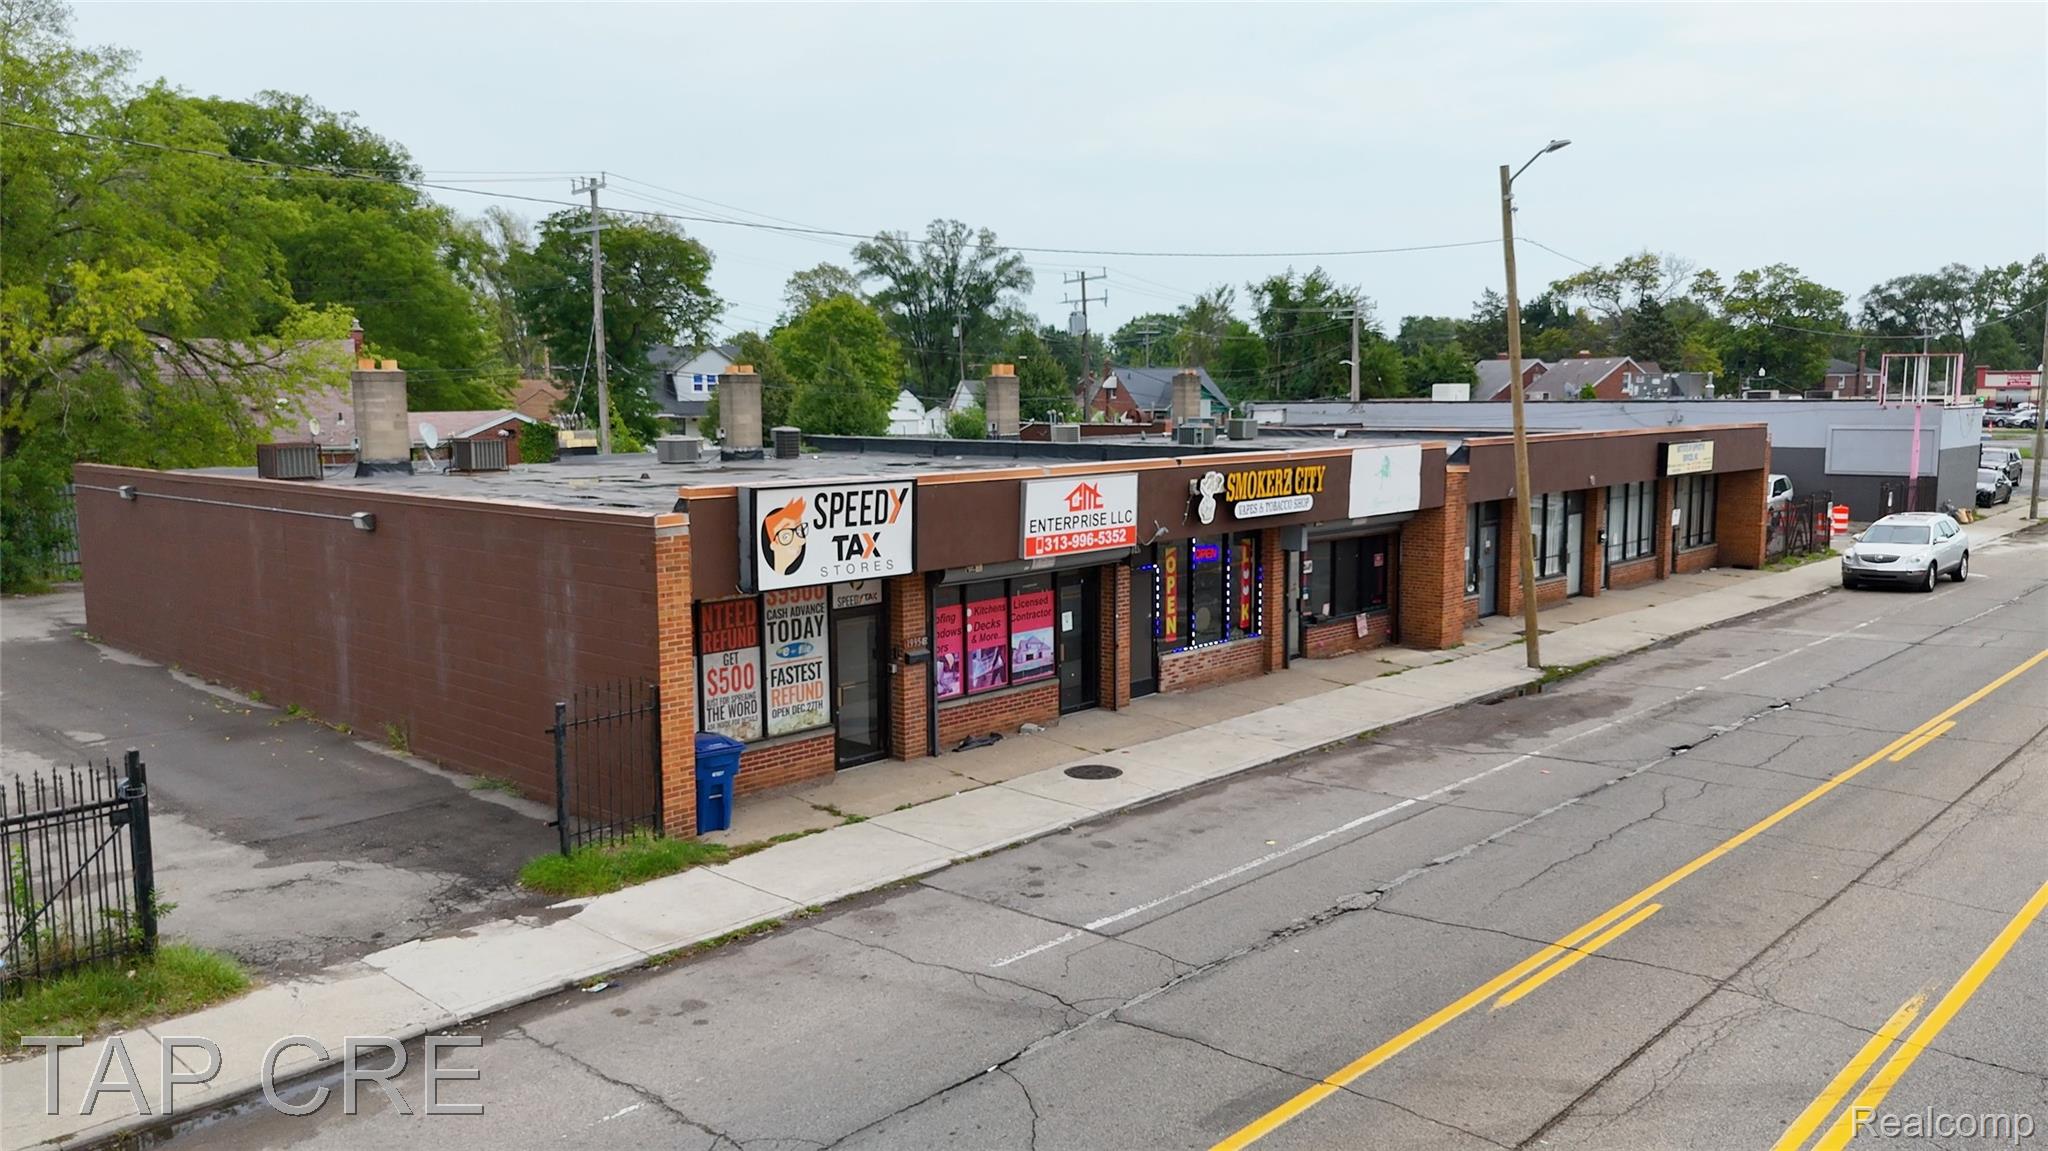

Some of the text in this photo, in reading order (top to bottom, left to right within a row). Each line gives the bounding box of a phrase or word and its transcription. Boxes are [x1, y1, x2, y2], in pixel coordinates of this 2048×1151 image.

[1226, 465, 1326, 502] SMOKERZ CITY
[813, 487, 909, 530] SPEEDY
[1029, 510, 1133, 534] ENTERPRISE LLC
[832, 531, 881, 562] TAX
[1044, 528, 1127, 552] 313-996-5352
[1196, 549, 1217, 559] OPEN
[820, 559, 895, 578] STORES
[1013, 596, 1049, 609] Licensed
[1165, 556, 1177, 635] OPEN
[766, 603, 825, 621] CASH ADVANCE
[973, 604, 1006, 616] Kitchens
[1011, 608, 1052, 622] Contractor
[767, 615, 824, 644] TODAY
[974, 619, 1001, 632] Decks
[702, 626, 757, 653] REFUND
[971, 634, 977, 644] &
[723, 651, 739, 666] GET
[707, 663, 754, 696] $500
[770, 661, 823, 687] FASTEST
[771, 681, 824, 708] REFUND
[706, 700, 758, 723] THE WORD
[771, 707, 790, 719] OPEN
